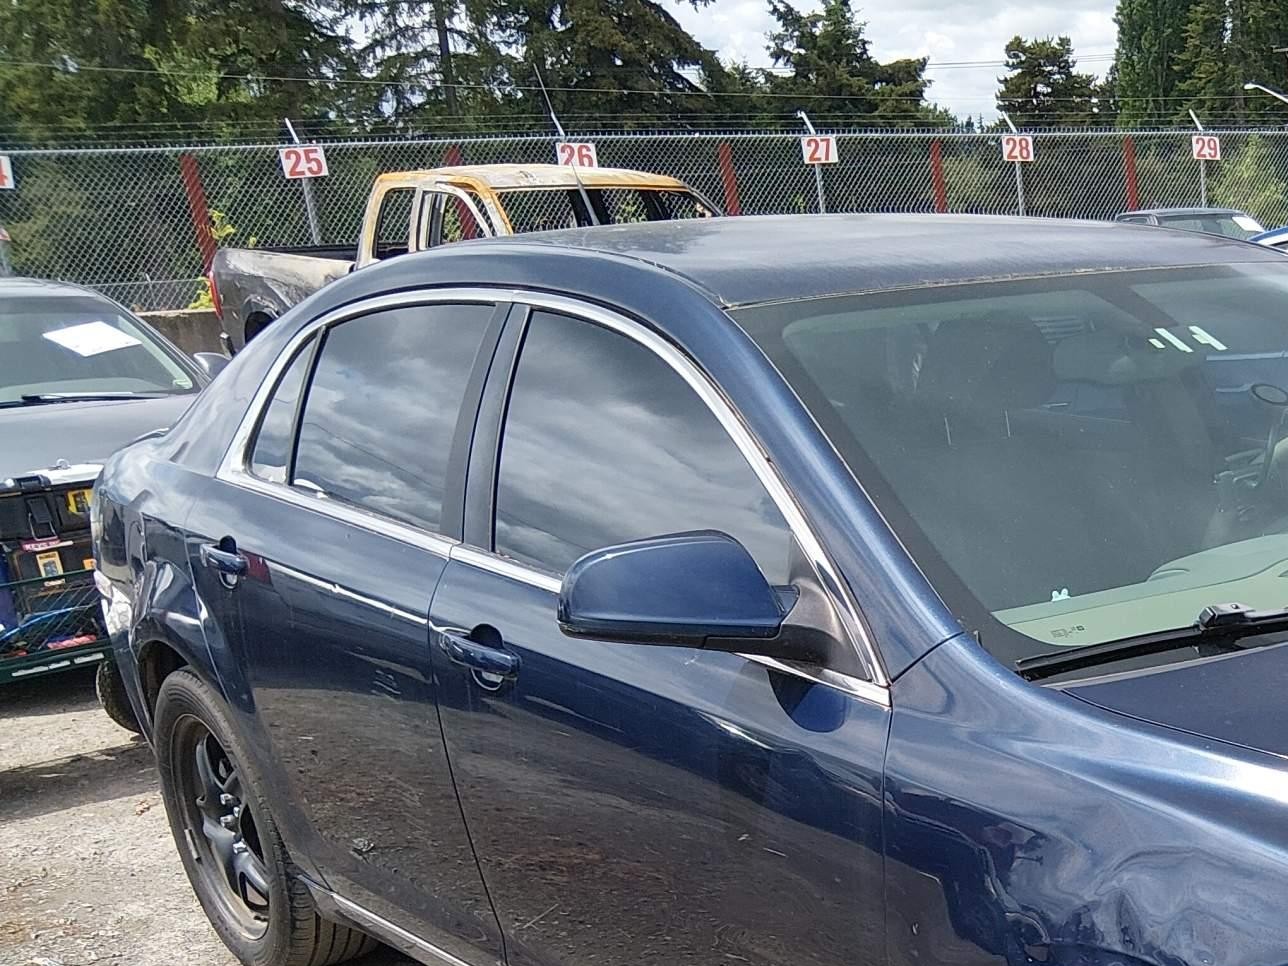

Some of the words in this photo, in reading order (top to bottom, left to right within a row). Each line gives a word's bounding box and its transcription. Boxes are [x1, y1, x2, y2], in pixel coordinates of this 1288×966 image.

[560, 144, 594, 167] 26
[806, 138, 831, 162] 27
[1005, 137, 1031, 160] 28
[1195, 137, 1218, 159] 29
[285, 148, 323, 176] 25
